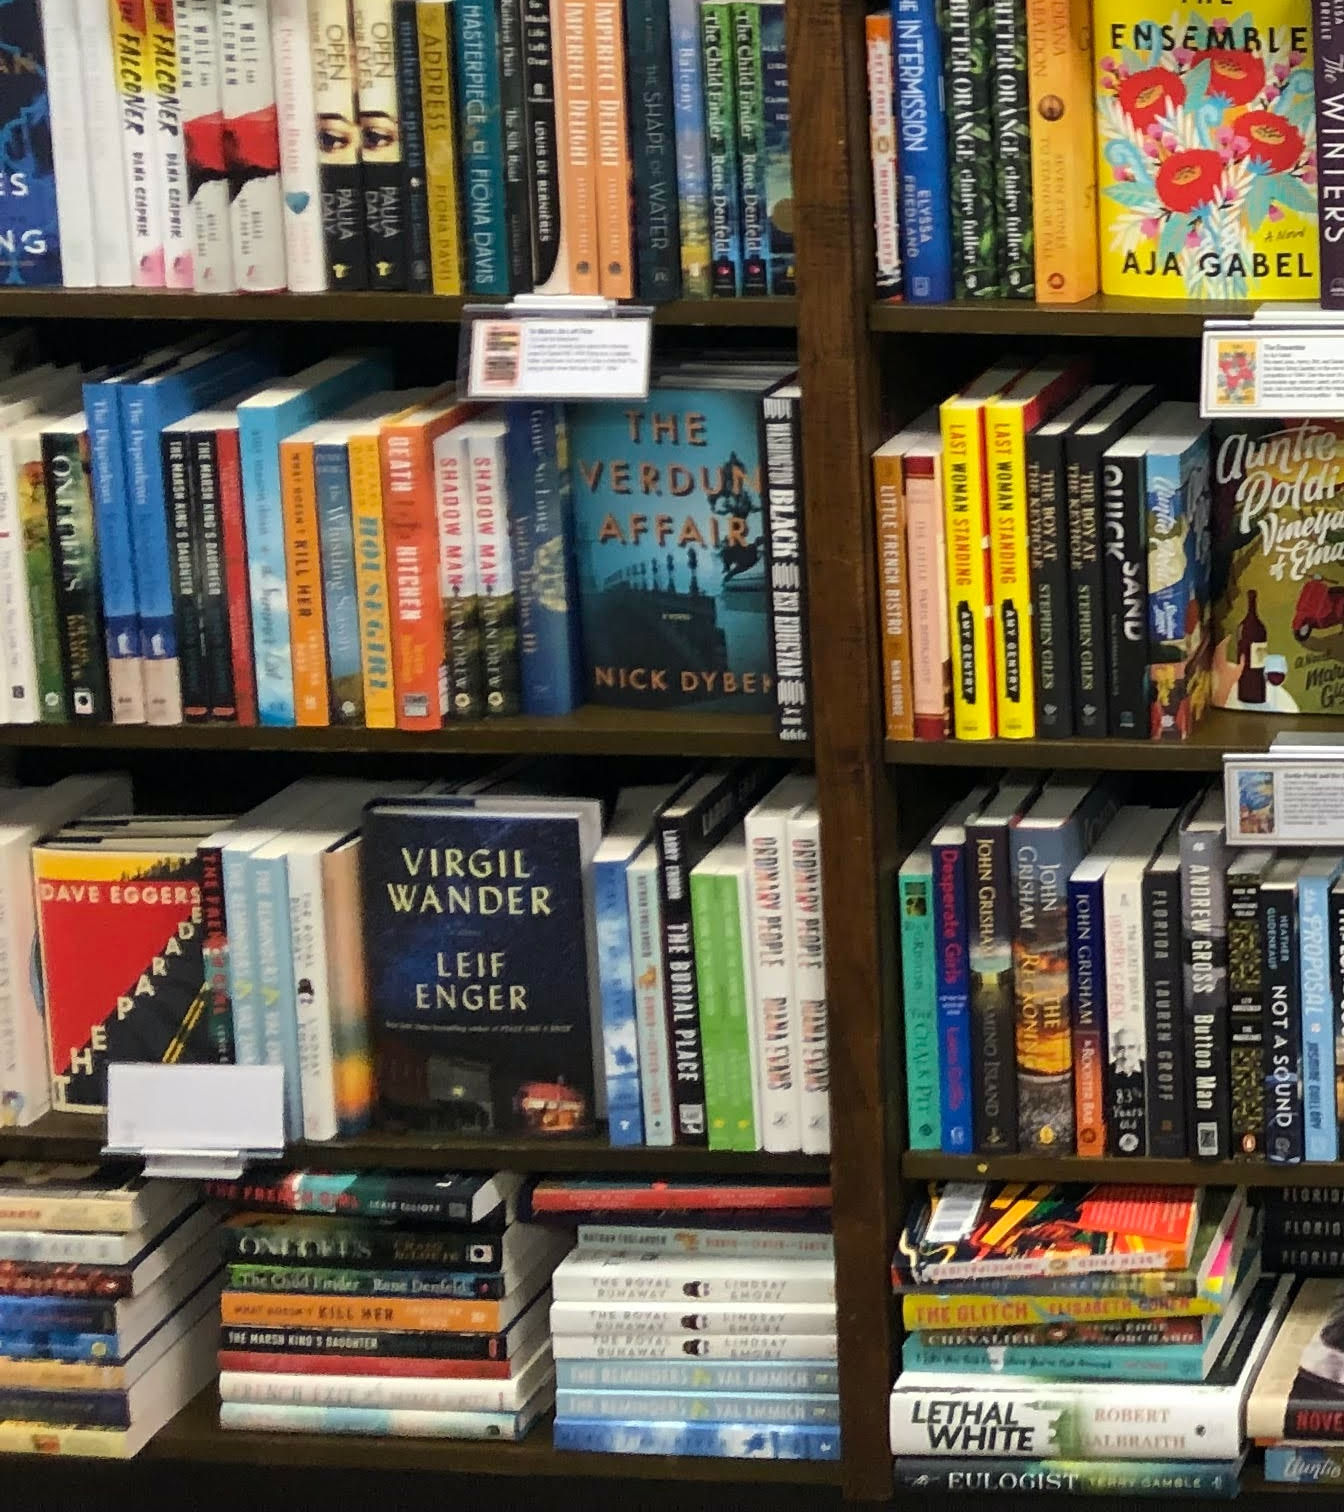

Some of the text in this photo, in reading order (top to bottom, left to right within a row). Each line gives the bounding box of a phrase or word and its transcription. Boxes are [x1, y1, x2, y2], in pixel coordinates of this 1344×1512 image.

[1110, 24, 1308, 54] ENSEMBLE
[1122, 253, 1313, 278] AJA GABEL
[599, 514, 749, 548] AFFAIR
[400, 847, 531, 880] VIRGIL
[41, 883, 201, 905] DAVE EGGERS
[387, 883, 553, 917] WANDER
[436, 952, 506, 978] LEIF
[416, 984, 529, 1011] ENGER
[912, 1401, 1019, 1425] LETHAL
[927, 1426, 1035, 1452] WHITE
